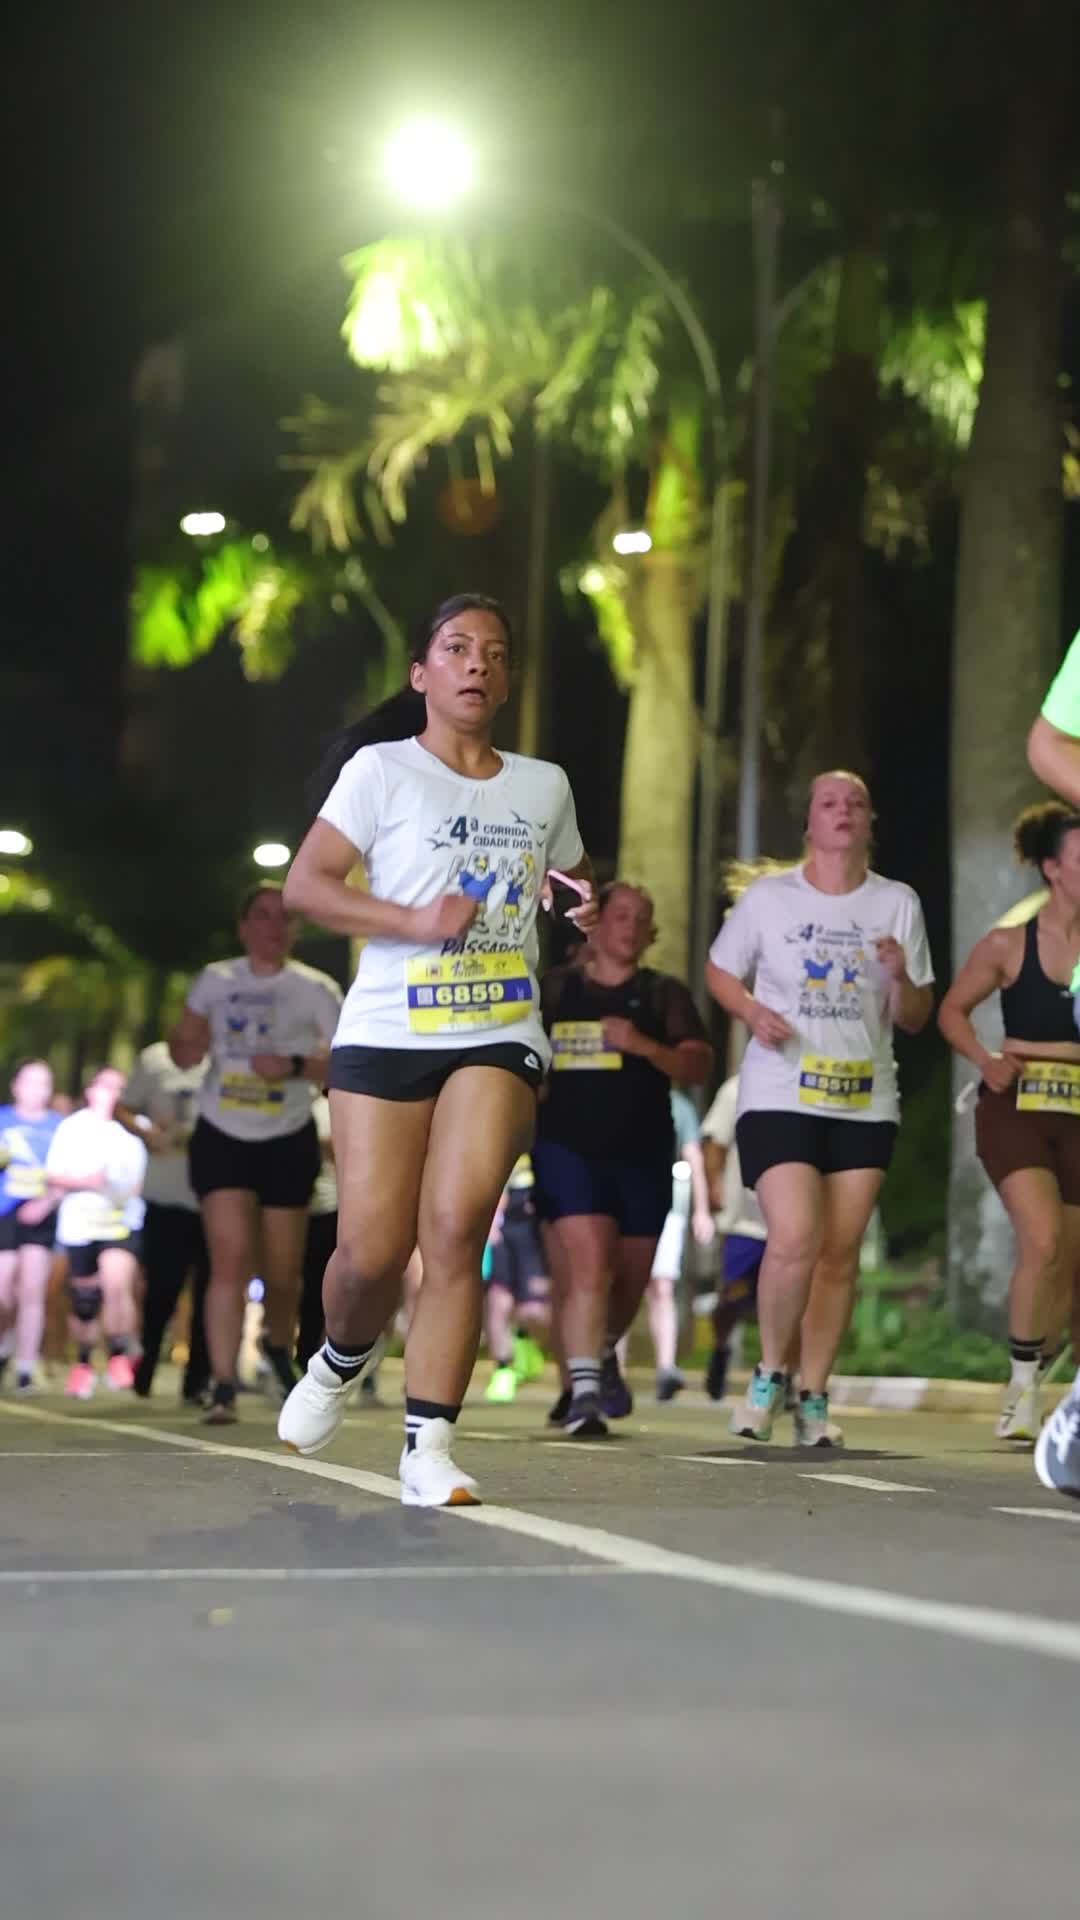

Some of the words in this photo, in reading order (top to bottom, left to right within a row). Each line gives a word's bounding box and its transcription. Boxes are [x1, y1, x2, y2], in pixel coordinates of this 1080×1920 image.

[483, 824, 529, 837] CORRIDA
[473, 835, 509, 848] CIDADE
[512, 838, 533, 850] DOS
[435, 981, 505, 1006] 6859
